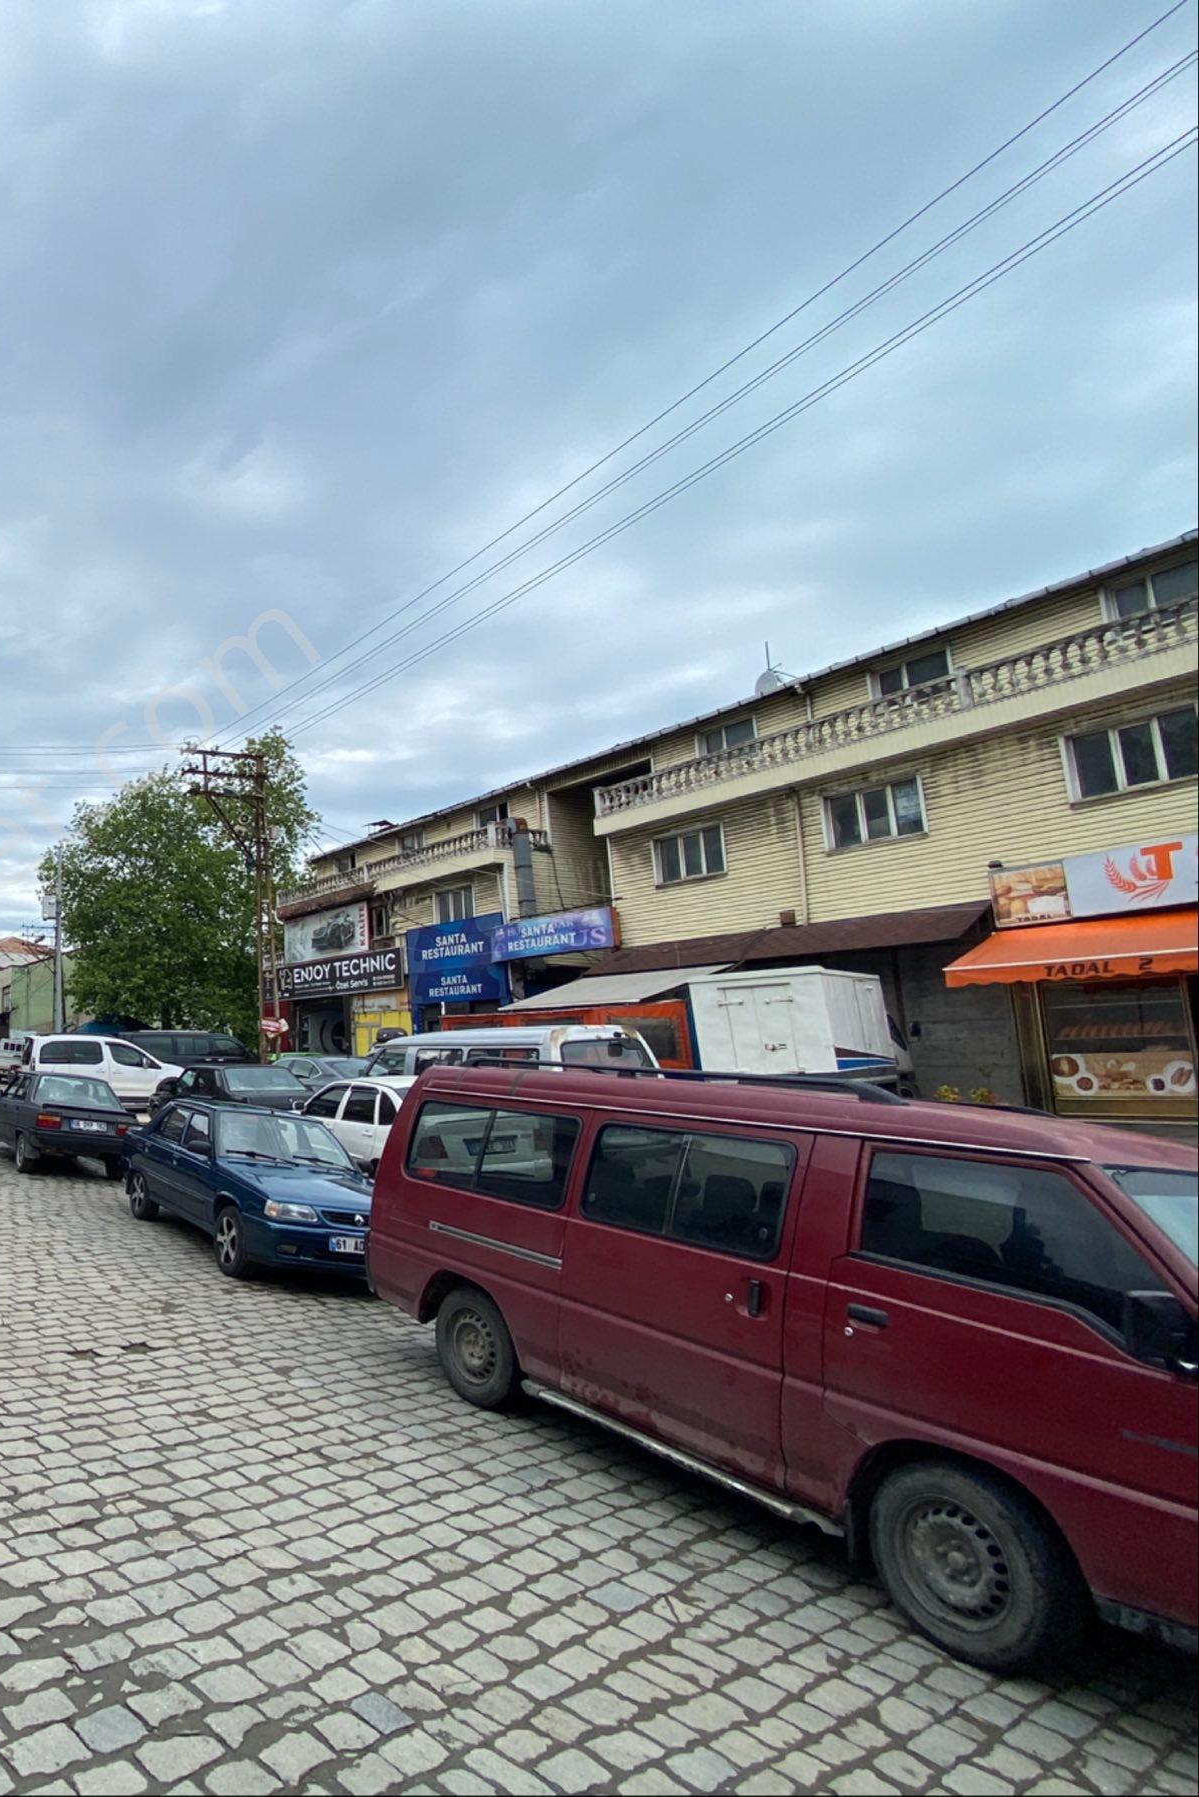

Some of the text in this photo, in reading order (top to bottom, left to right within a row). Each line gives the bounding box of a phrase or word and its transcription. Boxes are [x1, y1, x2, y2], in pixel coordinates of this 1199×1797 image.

[520, 923, 555, 938] SANTA
[435, 932, 467, 948] SANTA
[507, 932, 577, 952] RESTAURANT
[422, 941, 484, 960] RESTAURANT
[293, 953, 396, 983] ENJOY TECHNIC
[1044, 957, 1154, 977] TADAL 2
[440, 974, 468, 987] SANTA
[428, 983, 483, 997] RESTAURANT
[336, 1238, 347, 1250] 61
